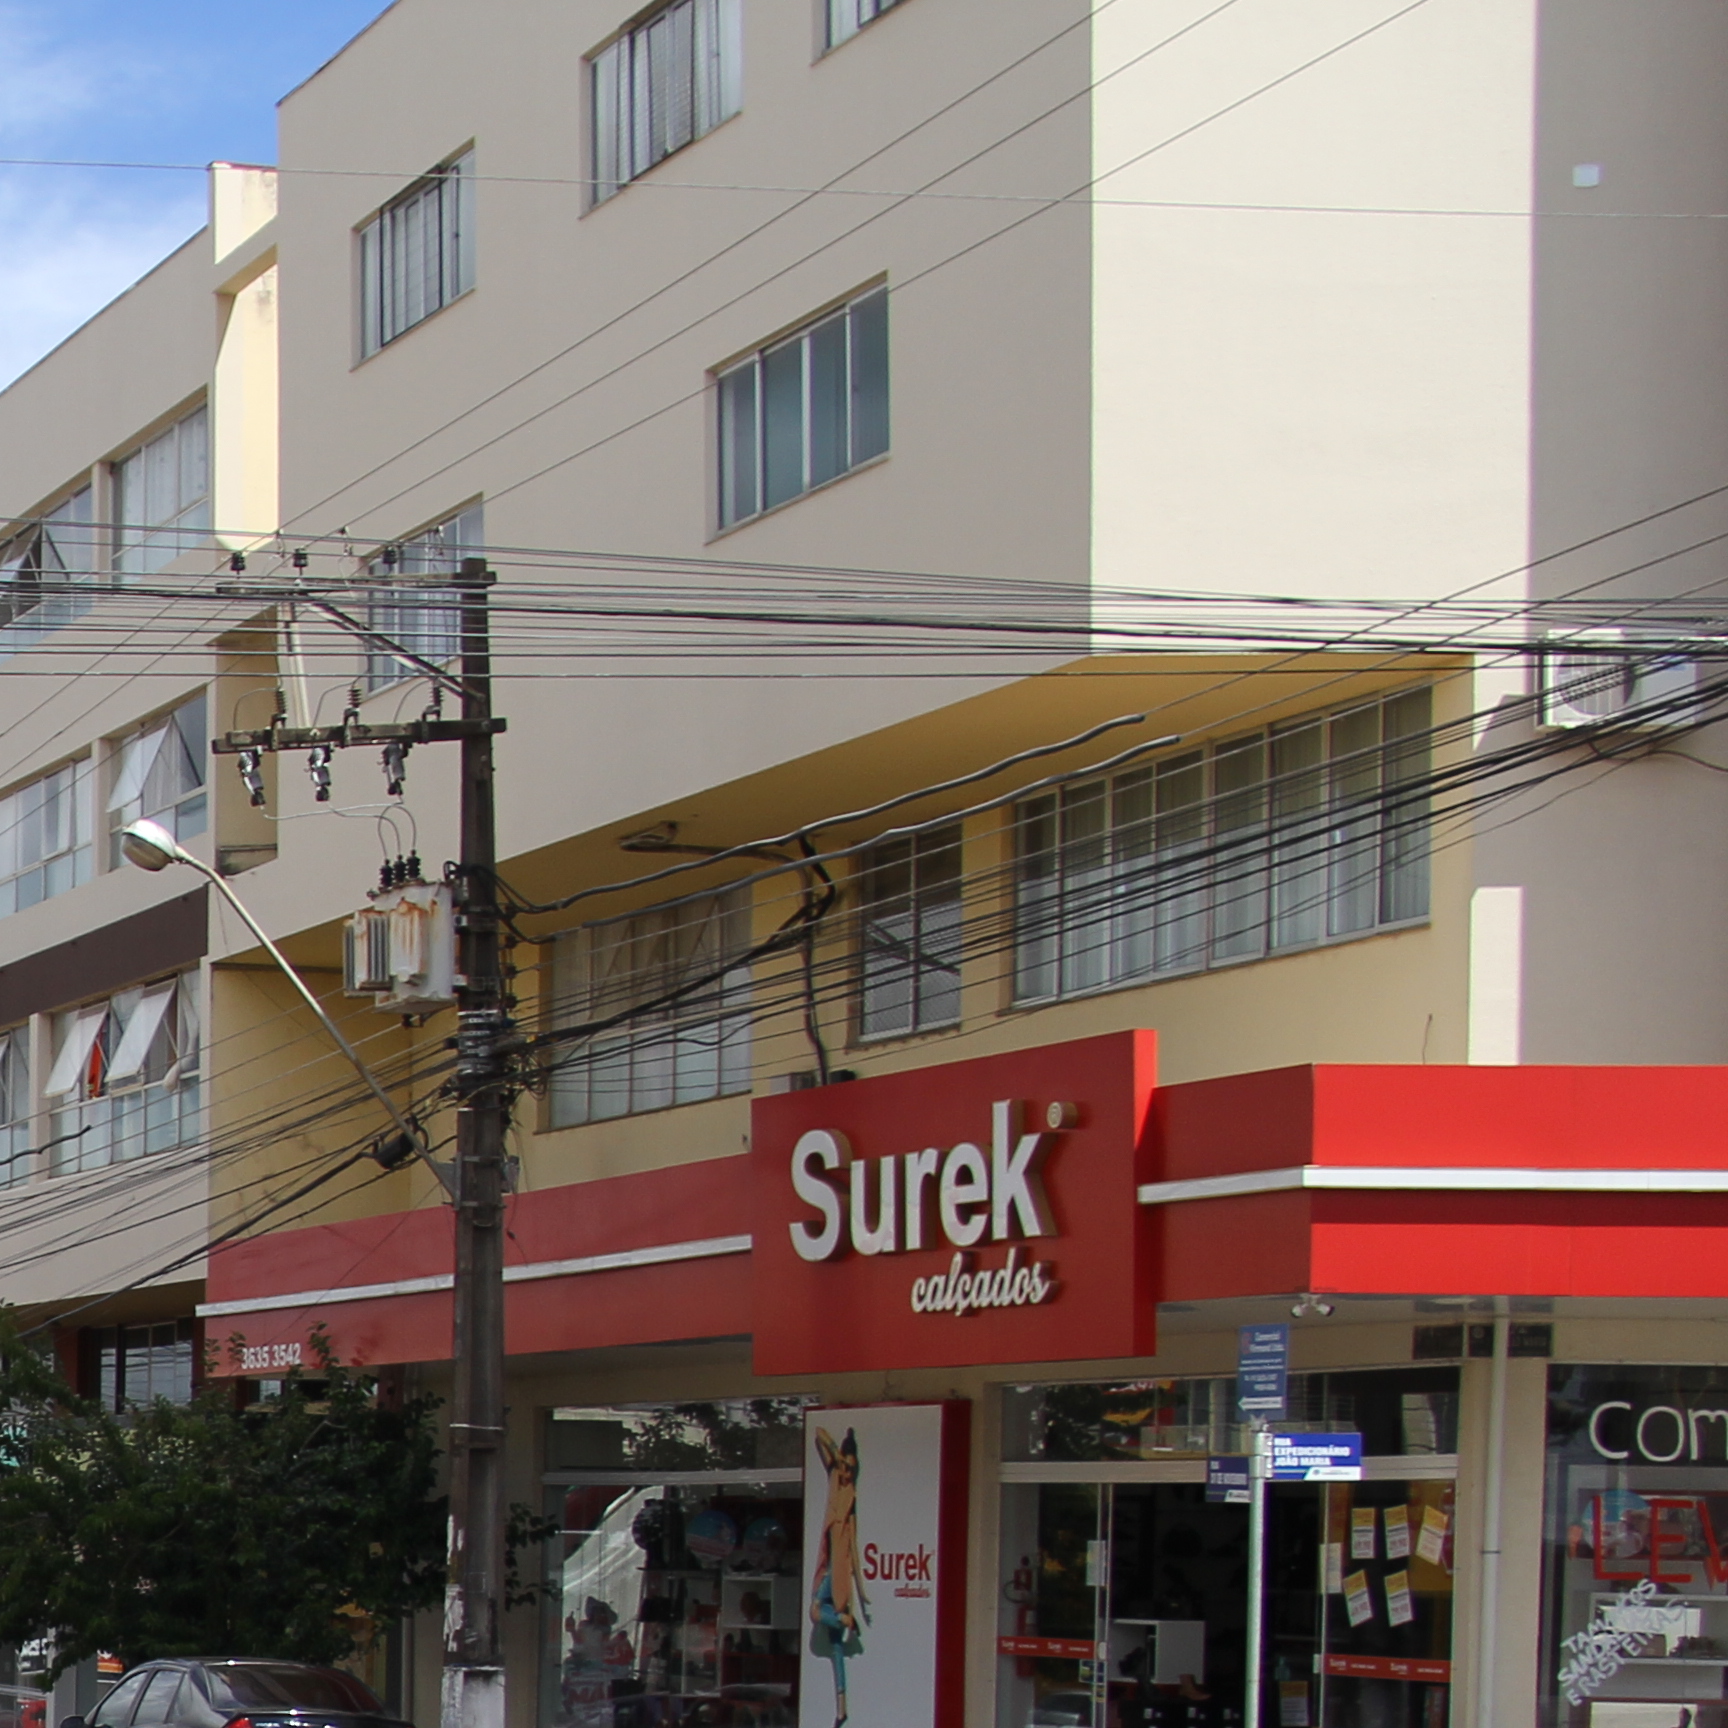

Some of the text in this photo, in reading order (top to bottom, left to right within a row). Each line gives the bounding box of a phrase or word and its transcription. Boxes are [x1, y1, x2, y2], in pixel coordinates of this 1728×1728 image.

[788, 1099, 1043, 1263] Surek
[910, 1247, 1049, 1317] calçados
[241, 1342, 301, 1370] 3635 3542
[1274, 1437, 1292, 1447] RUA
[1274, 1444, 1351, 1457] EXPEDICIONÁRIO
[1274, 1455, 1332, 1467] JOÃO MARIA
[863, 1542, 932, 1581] Surek
